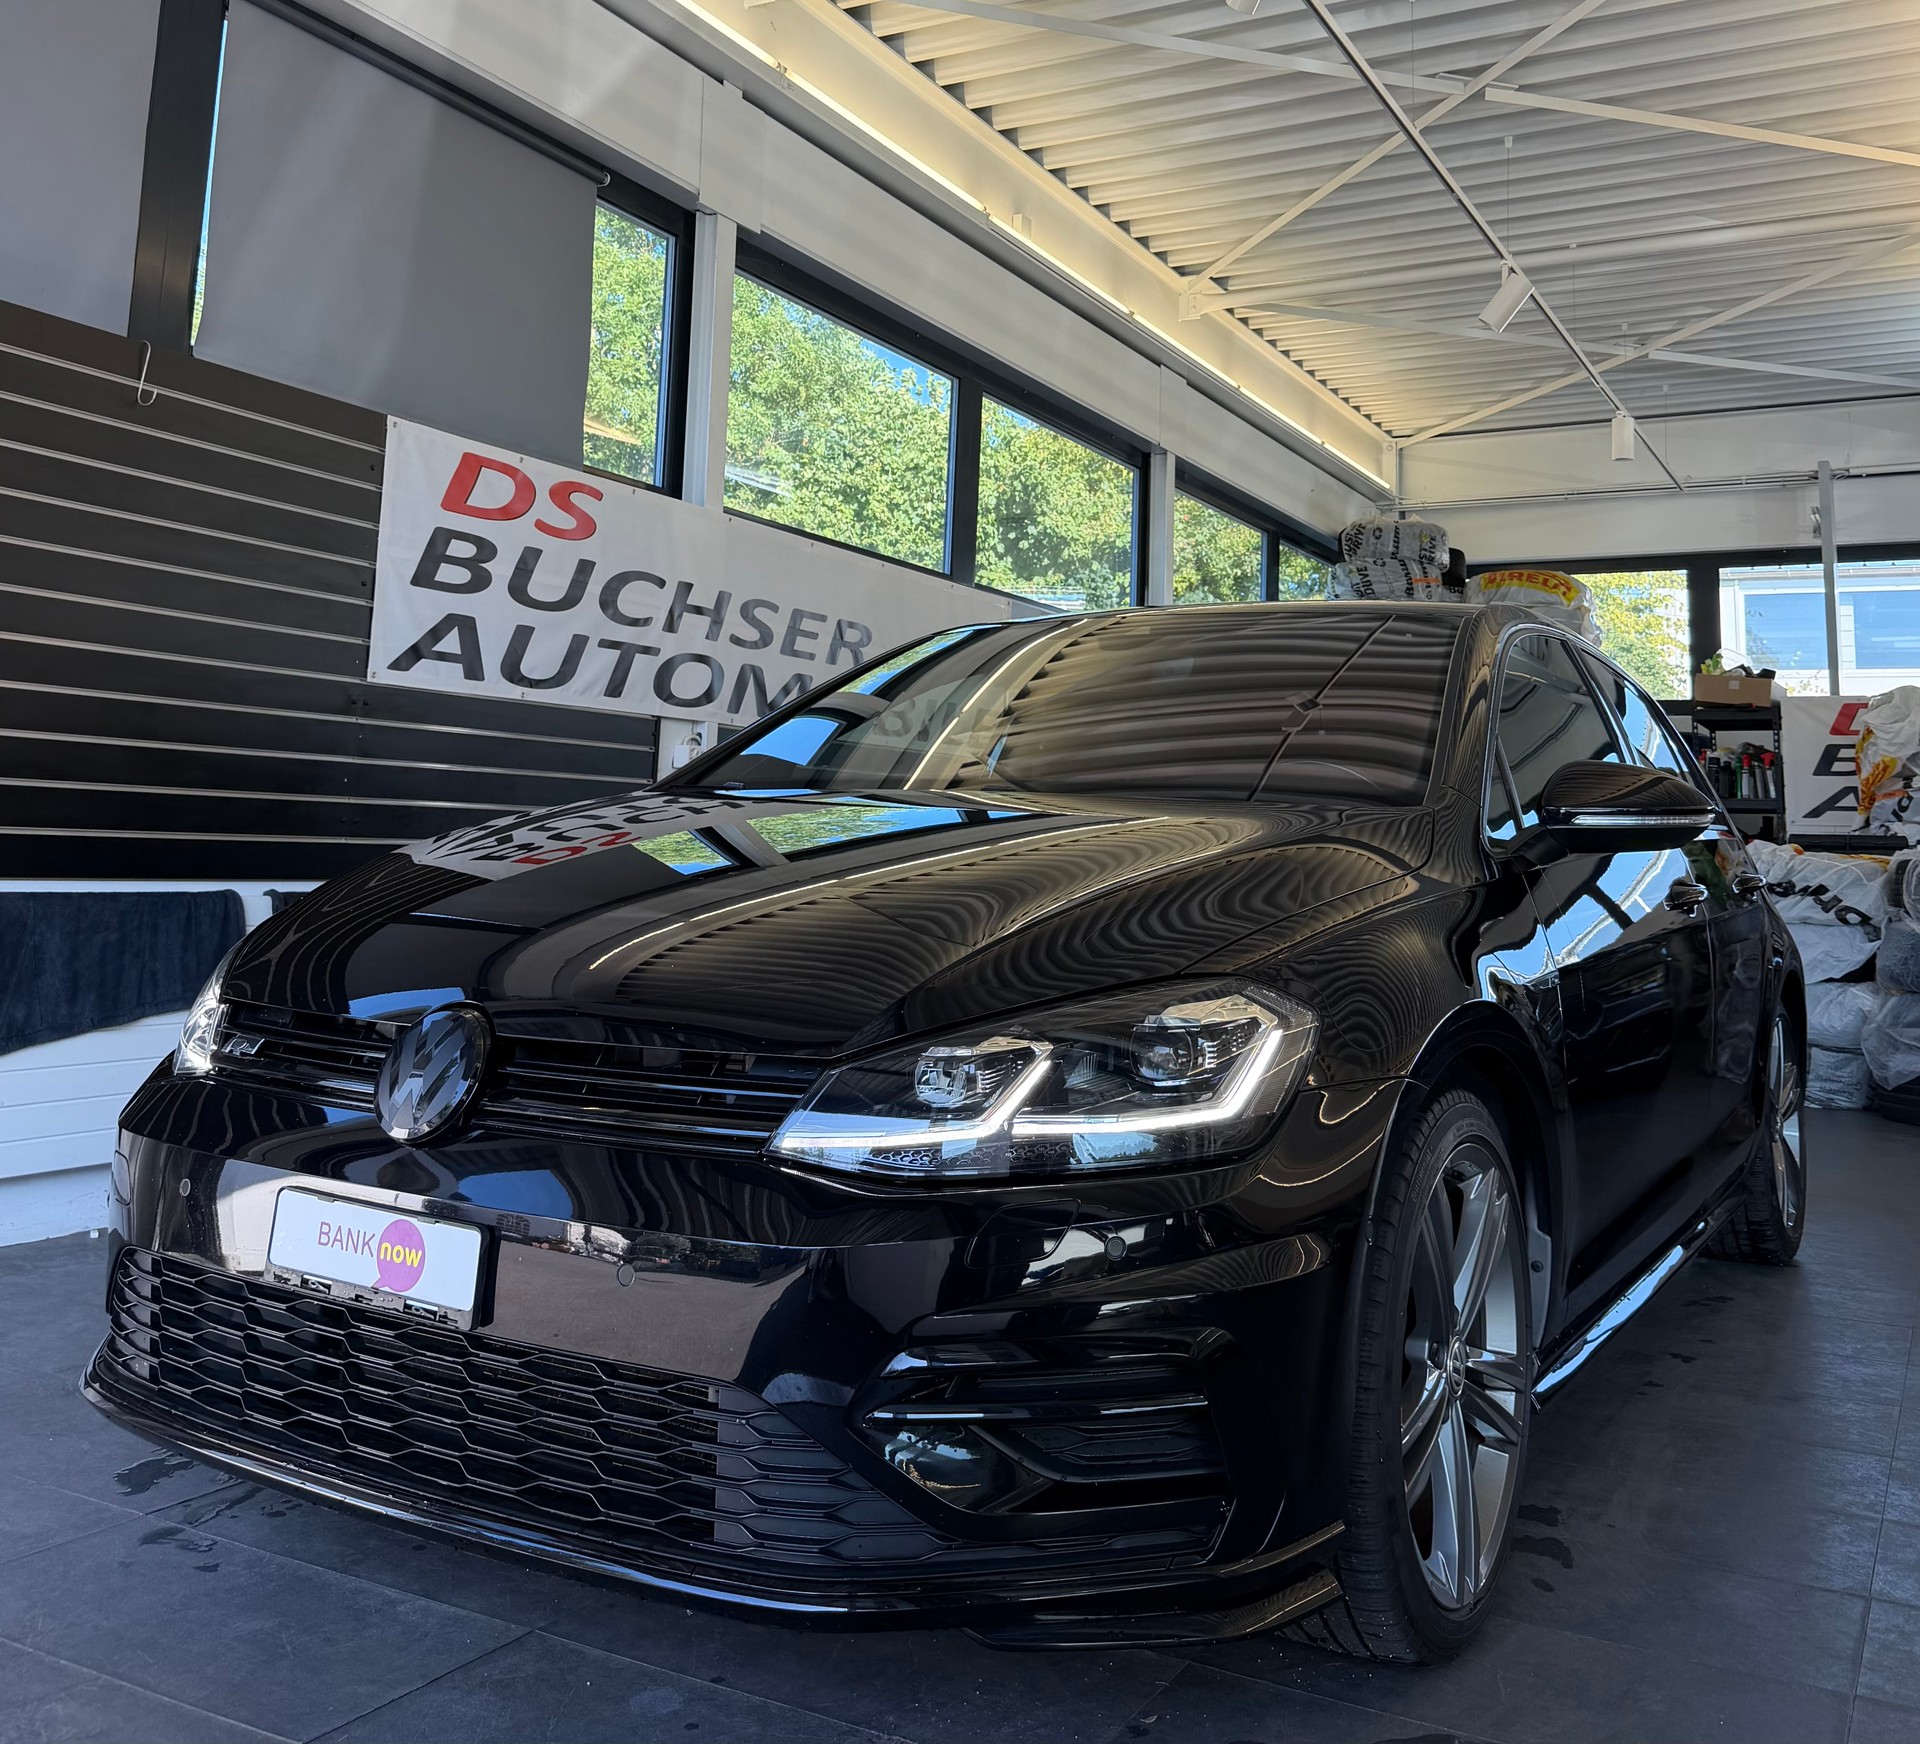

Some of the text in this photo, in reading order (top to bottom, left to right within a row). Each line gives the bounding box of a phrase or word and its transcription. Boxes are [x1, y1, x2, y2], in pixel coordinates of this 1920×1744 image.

[440, 452, 603, 541] DS
[410, 526, 873, 666] BUCHSER
[317, 1221, 423, 1268] BANK now
